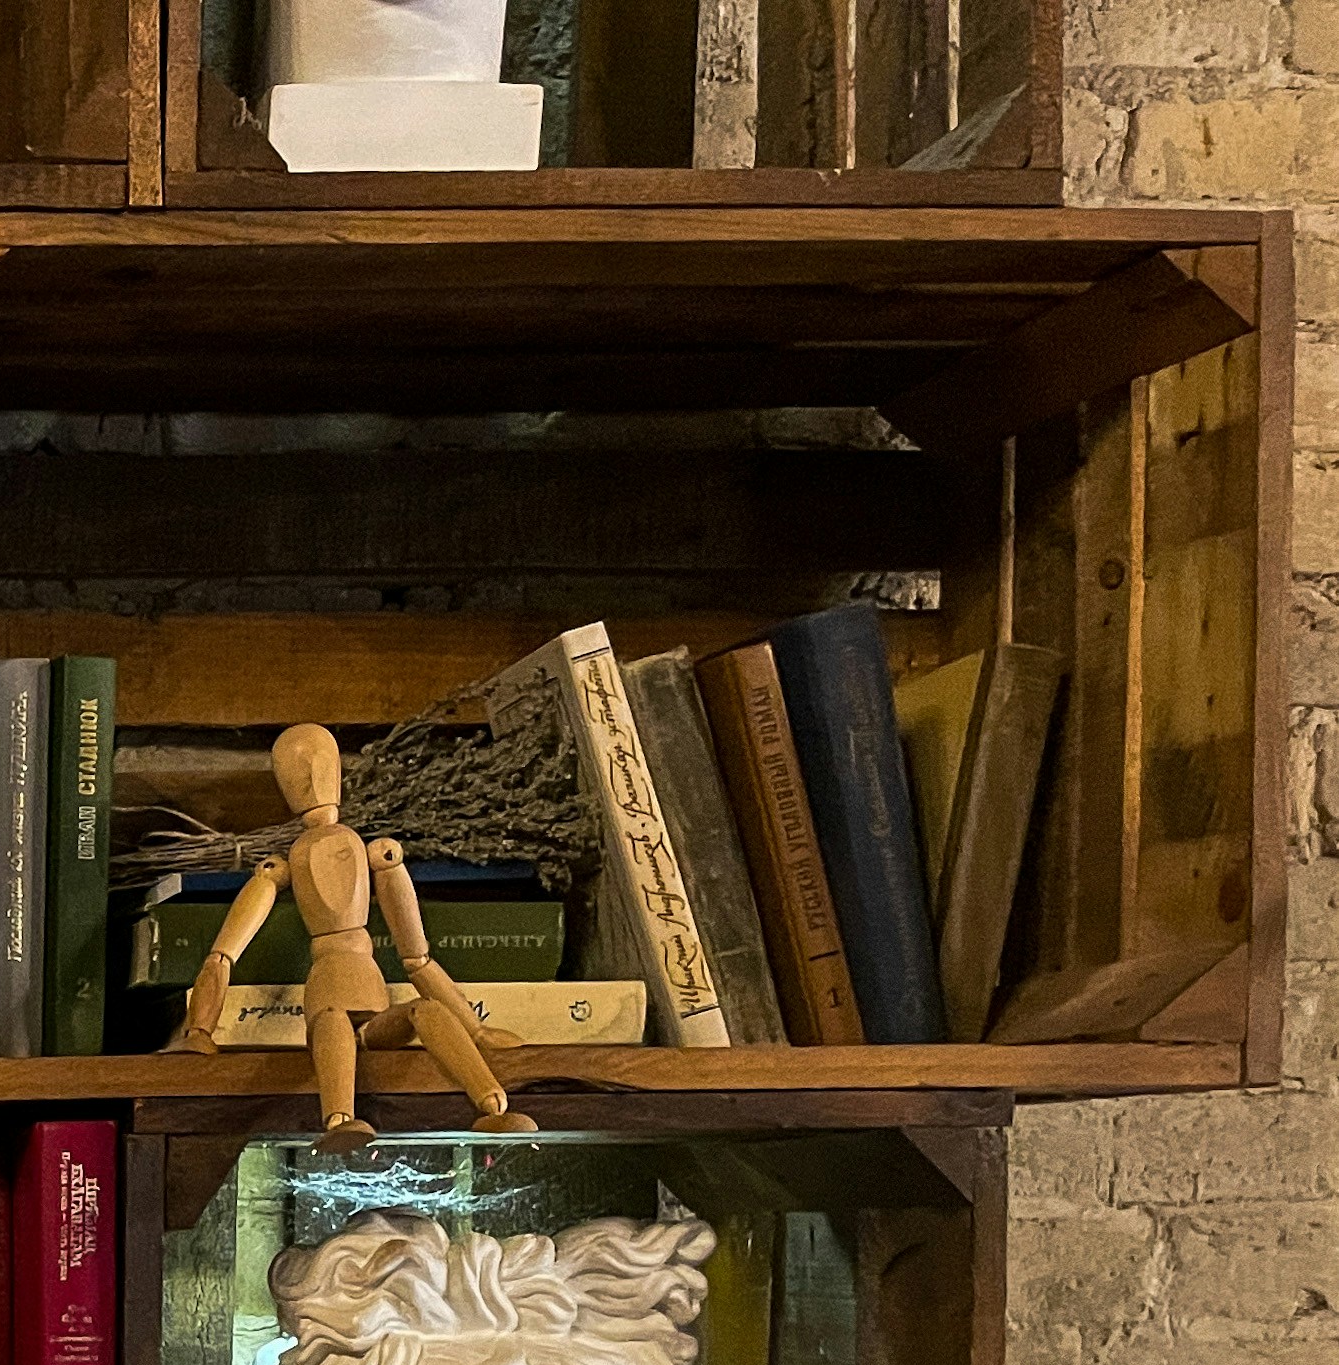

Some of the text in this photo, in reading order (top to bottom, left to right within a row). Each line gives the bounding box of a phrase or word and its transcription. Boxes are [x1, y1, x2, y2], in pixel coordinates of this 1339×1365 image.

[749, 685, 783, 746] РОМАН
[76, 698, 99, 860] ИВАН СТАДНЮК
